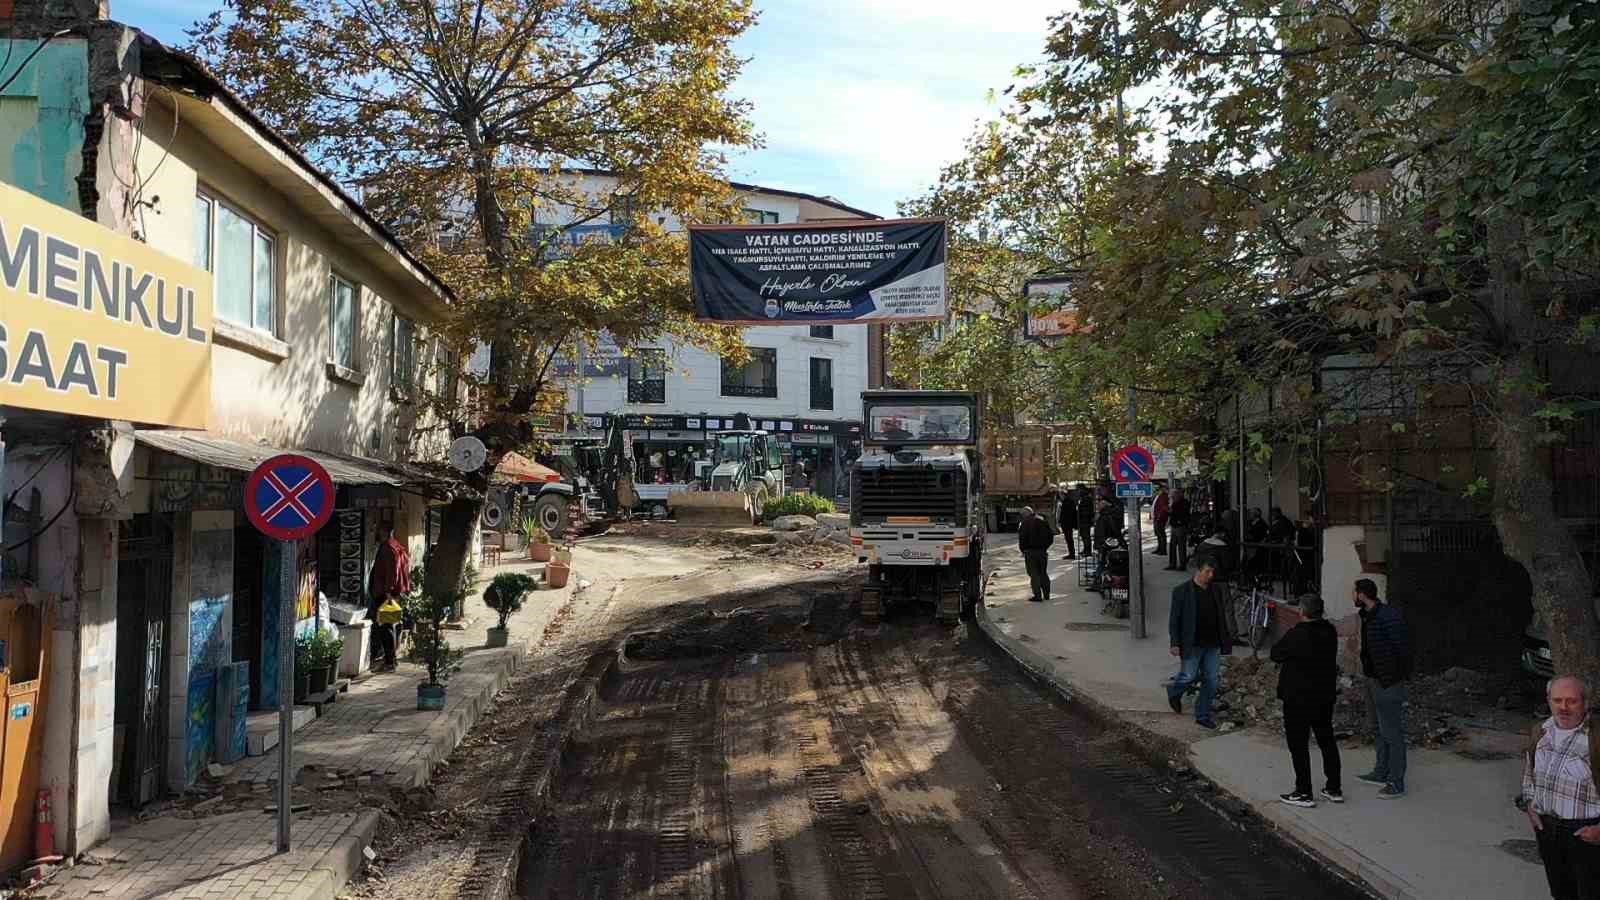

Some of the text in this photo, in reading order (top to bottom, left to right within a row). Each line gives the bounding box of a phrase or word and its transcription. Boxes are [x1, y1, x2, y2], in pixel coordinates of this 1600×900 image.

[745, 231, 884, 246] VATAN CADDESİ'NDE
[885, 251, 896, 259] VE
[0, 323, 127, 398] AAT
